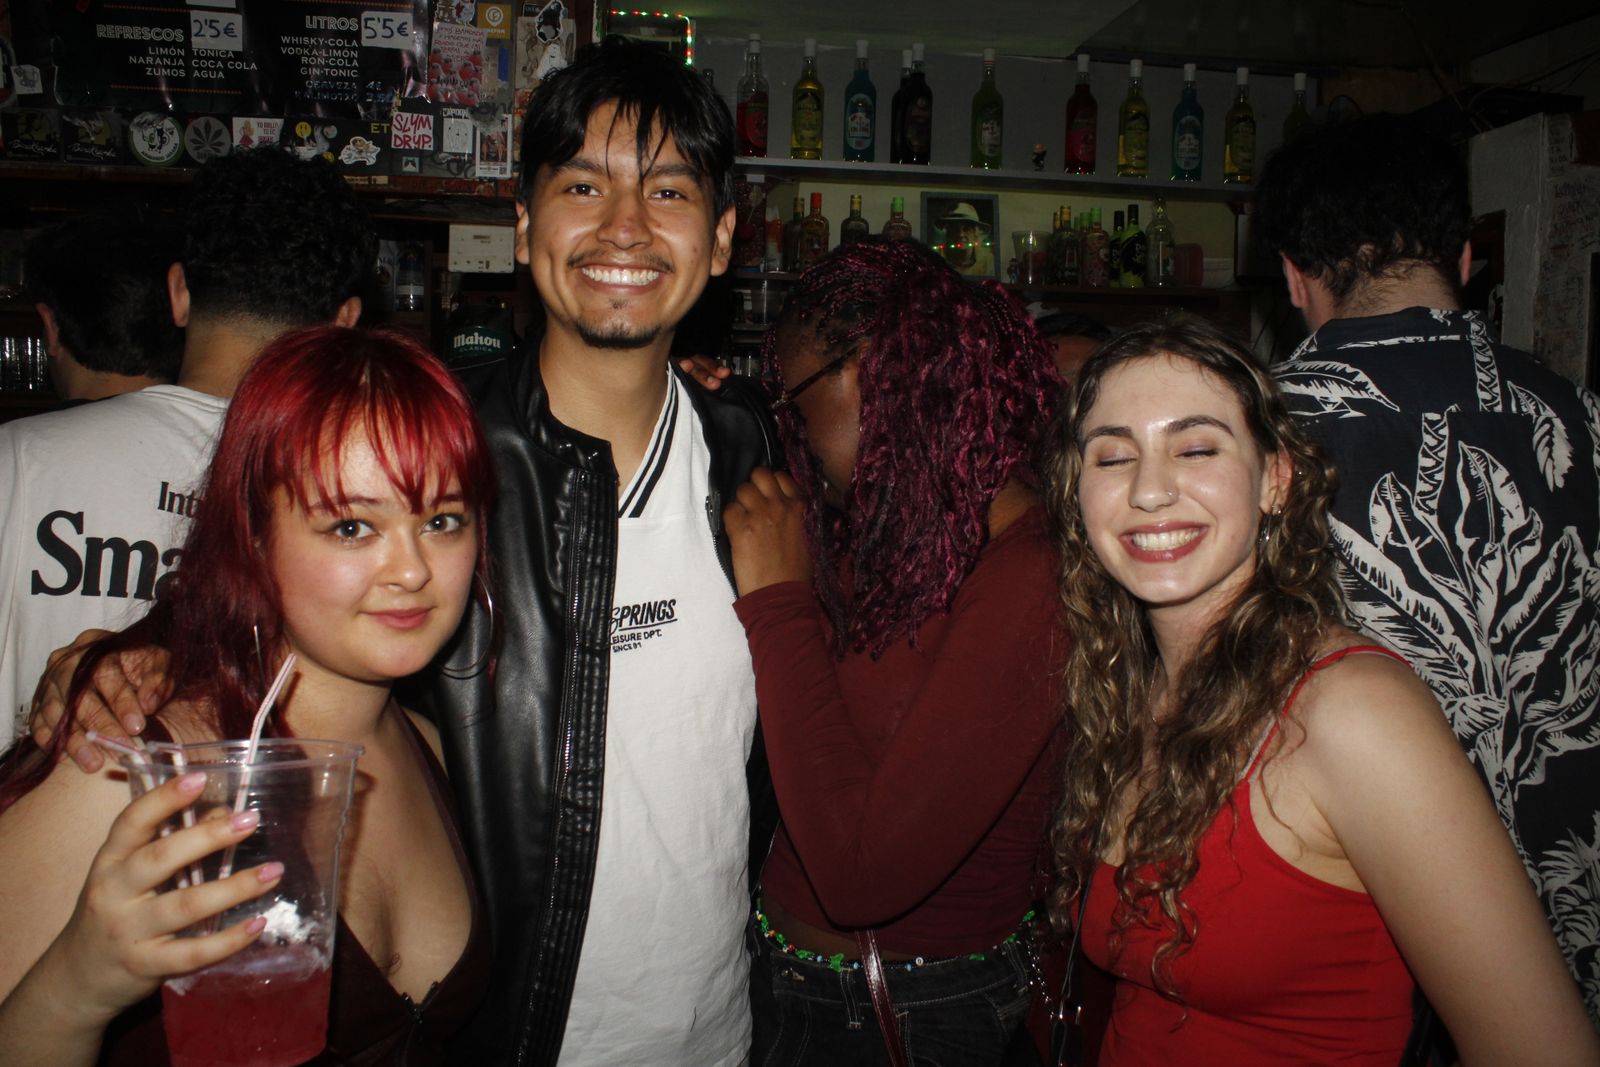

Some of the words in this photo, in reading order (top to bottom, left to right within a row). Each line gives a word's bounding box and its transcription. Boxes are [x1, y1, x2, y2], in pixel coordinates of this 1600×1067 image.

[305, 15, 359, 32] LITROS
[96, 24, 185, 43] REFRESCOS
[148, 45, 185, 57] LIMÓN
[128, 56, 185, 67] NARANJA
[192, 59, 224, 69] COCA
[227, 61, 258, 71] COLA
[145, 68, 186, 78] ZUMOS
[193, 69, 225, 79] AGUA
[393, 114, 432, 132] SLYM
[453, 332, 501, 349] Mahou
[611, 632, 642, 645] EISURE
[612, 643, 632, 653] SINCE
